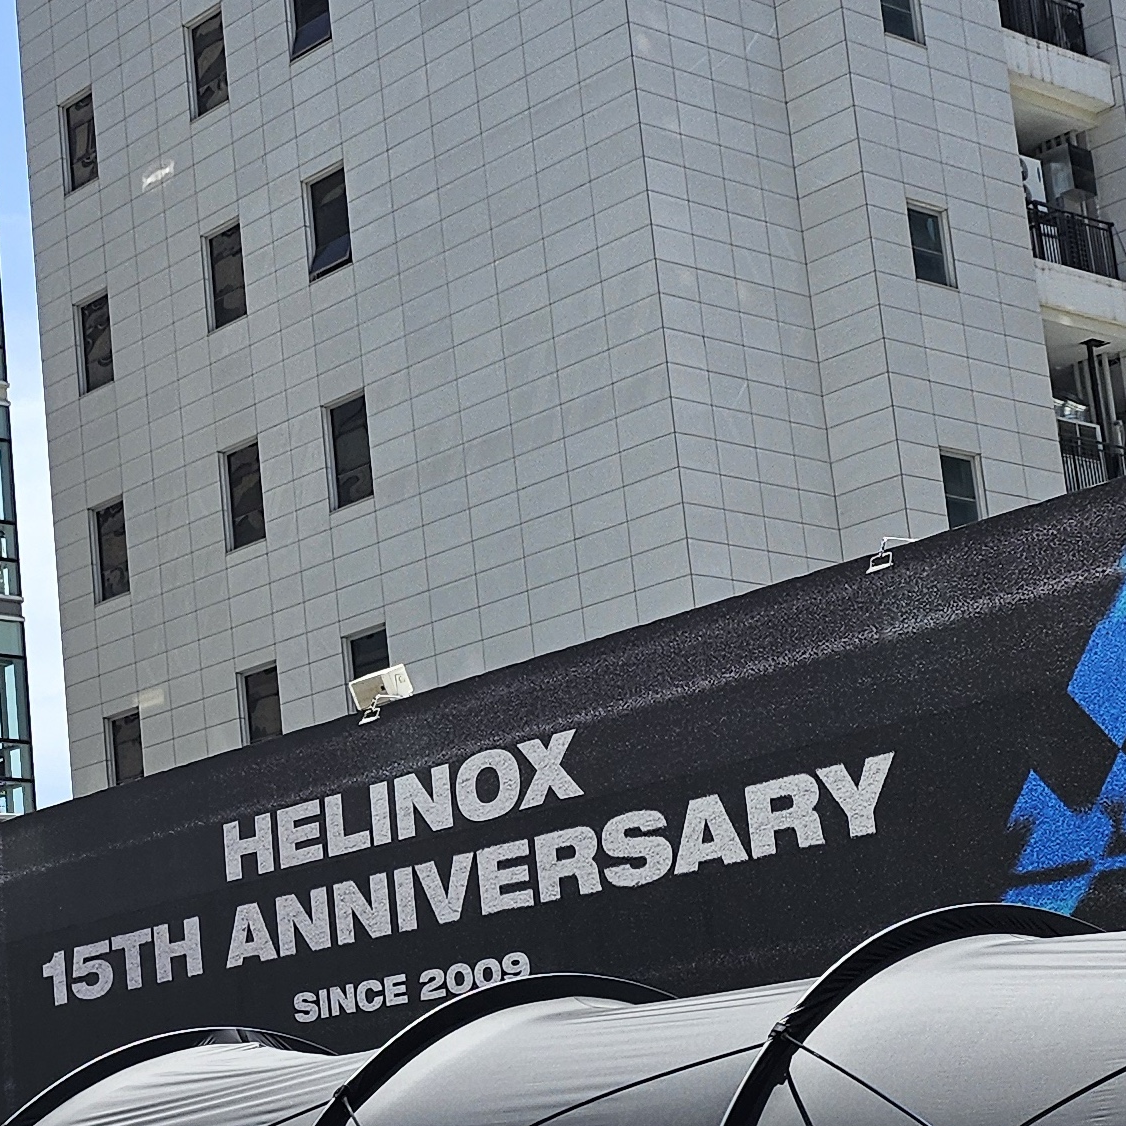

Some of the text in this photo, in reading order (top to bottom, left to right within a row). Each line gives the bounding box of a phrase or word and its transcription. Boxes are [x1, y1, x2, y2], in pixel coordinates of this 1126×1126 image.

[42, 752, 895, 1006] 15TH ANNIVERSARY
[223, 728, 584, 883] HELINOX
[293, 951, 531, 1023] SINCE 2009
